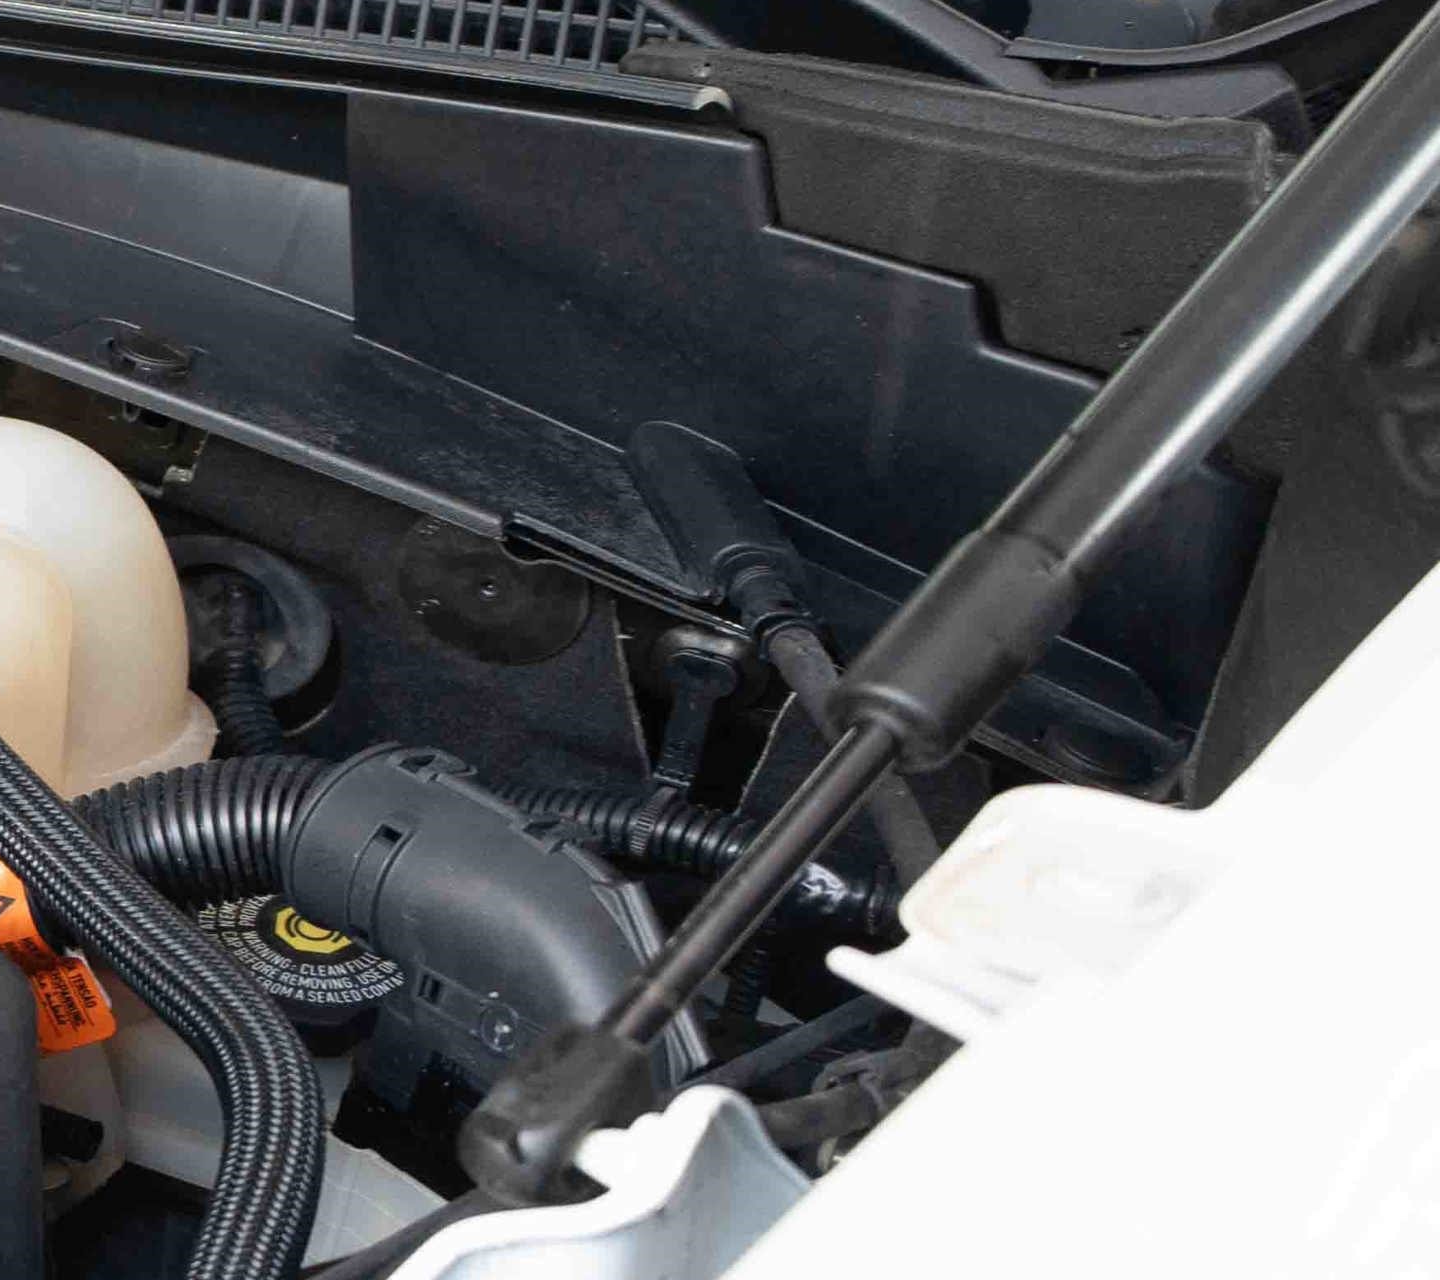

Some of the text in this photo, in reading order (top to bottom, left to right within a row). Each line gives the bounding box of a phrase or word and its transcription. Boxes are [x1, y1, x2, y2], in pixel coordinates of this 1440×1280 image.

[221, 931, 244, 947] CAP
[233, 948, 280, 980] BEFORE
[355, 968, 385, 985] USE
[299, 963, 348, 976] CLEAN
[344, 952, 381, 973] FILL
[295, 990, 305, 1001] A
[307, 990, 362, 1004] SEALED
[360, 972, 405, 999] CONTA
